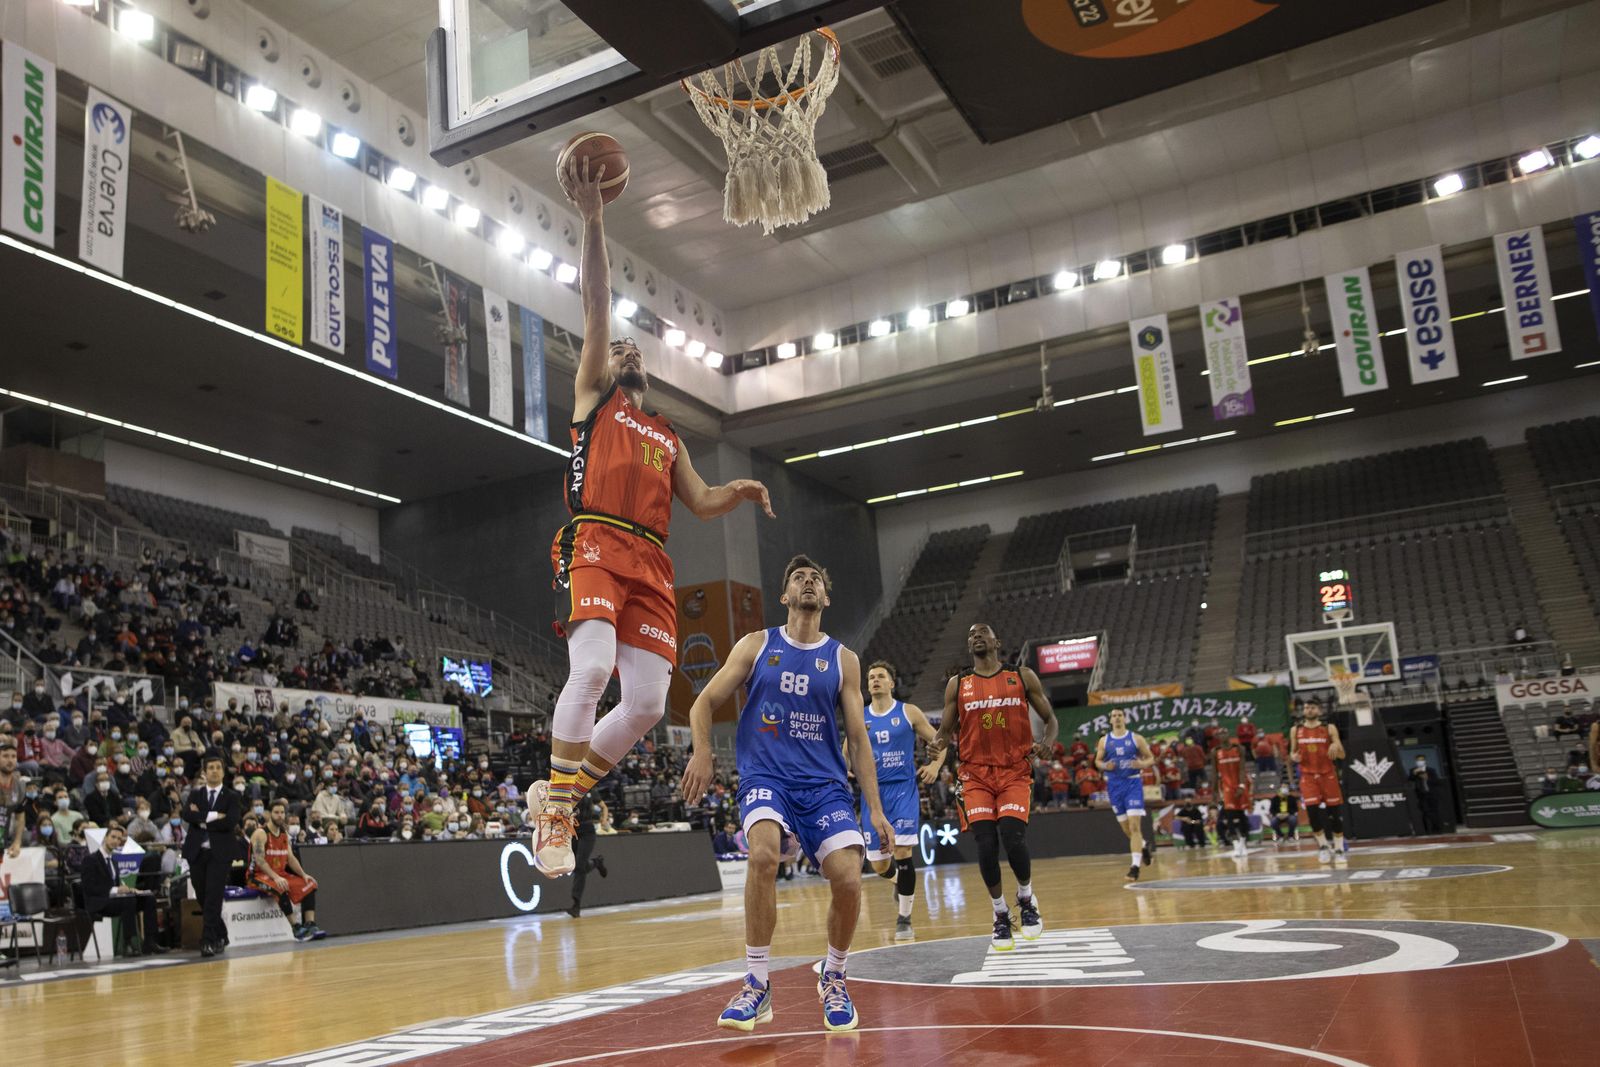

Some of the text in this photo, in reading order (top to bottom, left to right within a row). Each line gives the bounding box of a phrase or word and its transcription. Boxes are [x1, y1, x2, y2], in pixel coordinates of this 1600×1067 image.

[1112, 0, 1159, 28] ey
[98, 148, 123, 238] Cuerva
[327, 238, 341, 347] ESCOLANO
[1507, 232, 1542, 330] BERNER
[372, 243, 392, 368] PULEVA
[1407, 259, 1444, 346] asisa
[641, 441, 665, 472] 15
[1320, 584, 1346, 603] 22
[779, 671, 810, 696] 88
[789, 710, 826, 725] MELILLA
[789, 720, 820, 732] SPORT
[982, 711, 1006, 730] 34
[1077, 701, 1164, 737] FRNTE
[789, 729, 824, 742] CAPITAL
[875, 730, 890, 744] 19
[745, 788, 773, 806] 88
[231, 909, 284, 922] #Granada203
